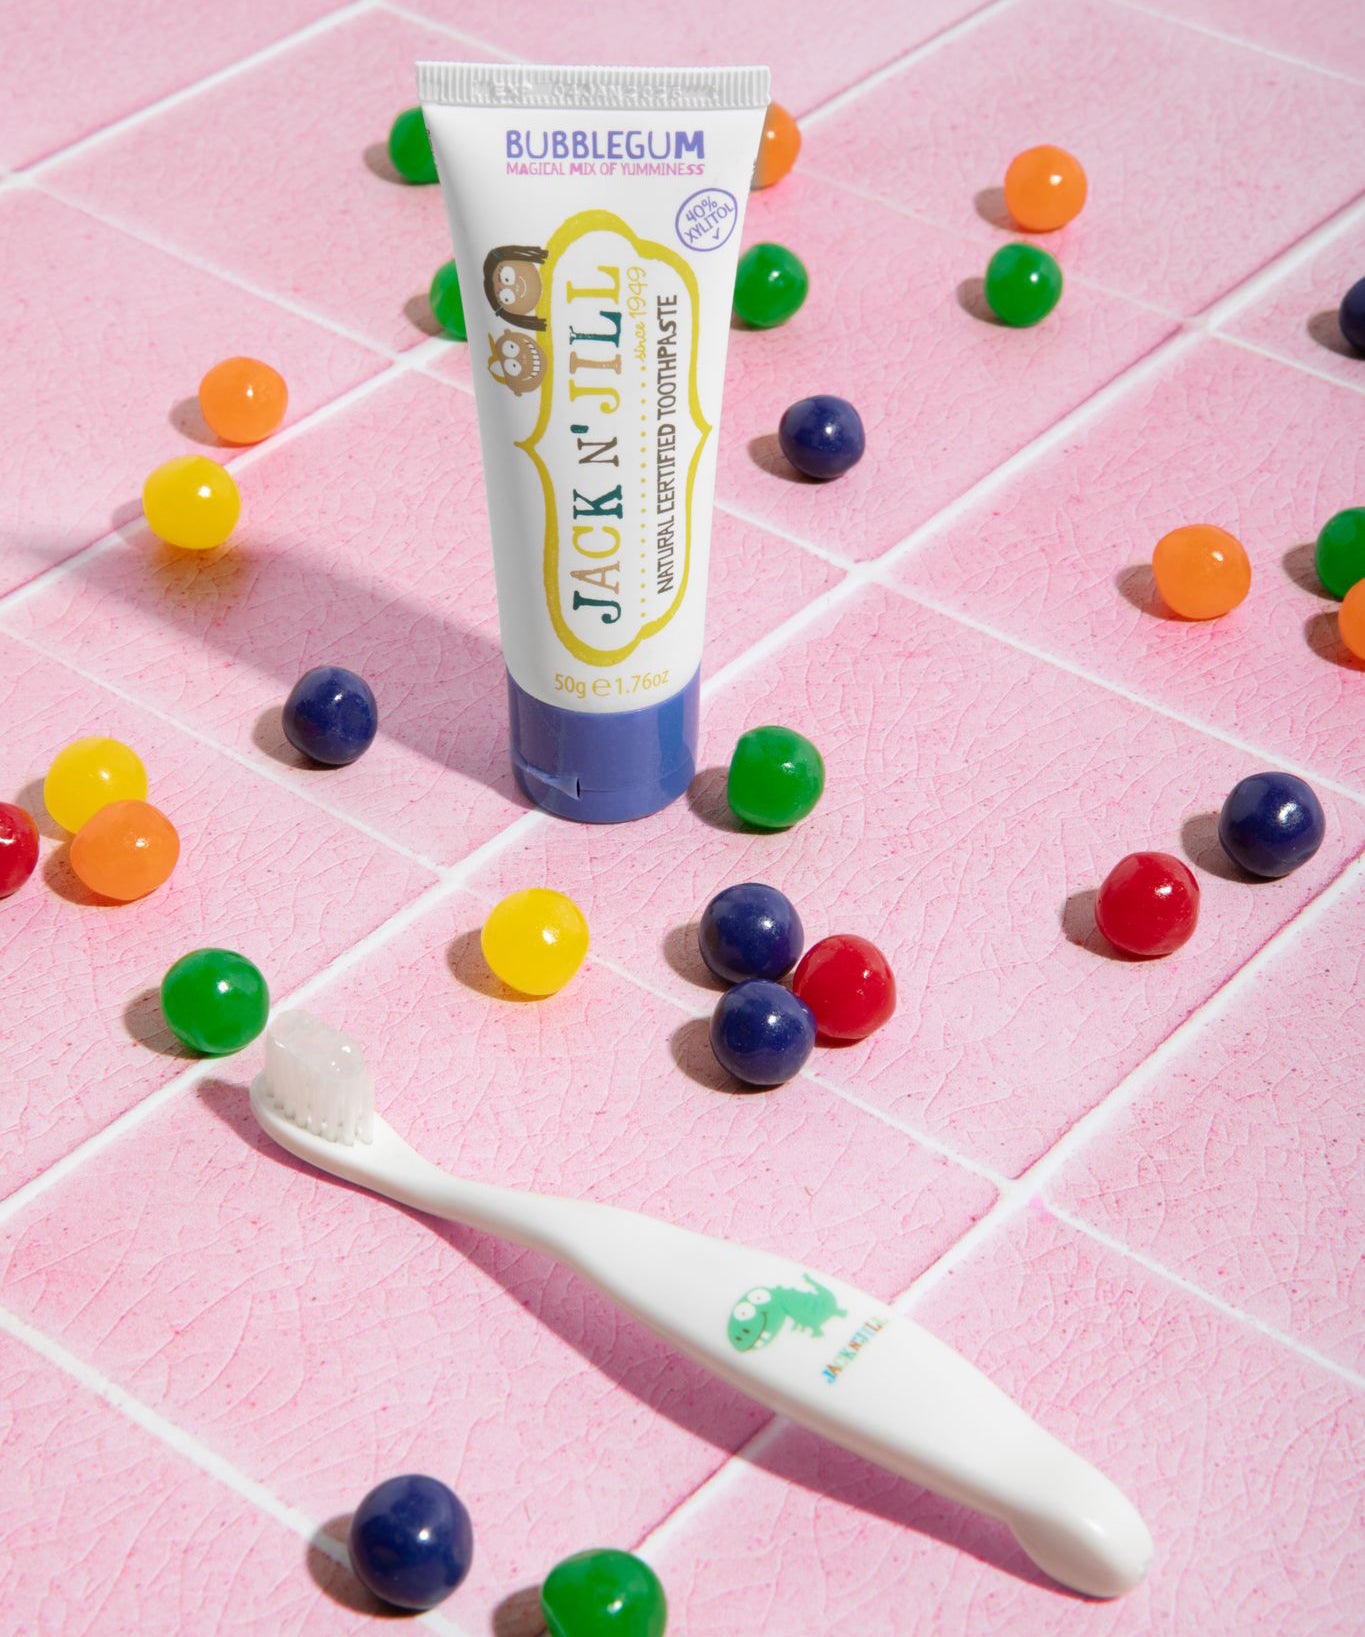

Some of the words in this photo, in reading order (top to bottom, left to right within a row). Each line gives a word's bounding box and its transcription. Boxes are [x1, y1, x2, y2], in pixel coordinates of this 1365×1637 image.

[506, 130, 705, 159] BUBBLEGUM
[506, 162, 565, 176] MAGICAL
[569, 162, 597, 176] MIX
[600, 162, 617, 176] OF
[621, 162, 705, 176] YUMMINESS
[684, 203, 734, 243] XYLITOL
[686, 195, 718, 222] 40%
[626, 266, 648, 318] 1949
[566, 265, 622, 414] JILL
[634, 321, 647, 361] since
[657, 295, 678, 420] TOOTHPASTE
[570, 424, 619, 467] N'
[656, 423, 676, 515] CERTIFIED
[570, 484, 623, 624] JACK
[657, 515, 675, 594] NATURAL
[554, 674, 587, 699] 50g
[616, 669, 669, 695] 1.76oz
